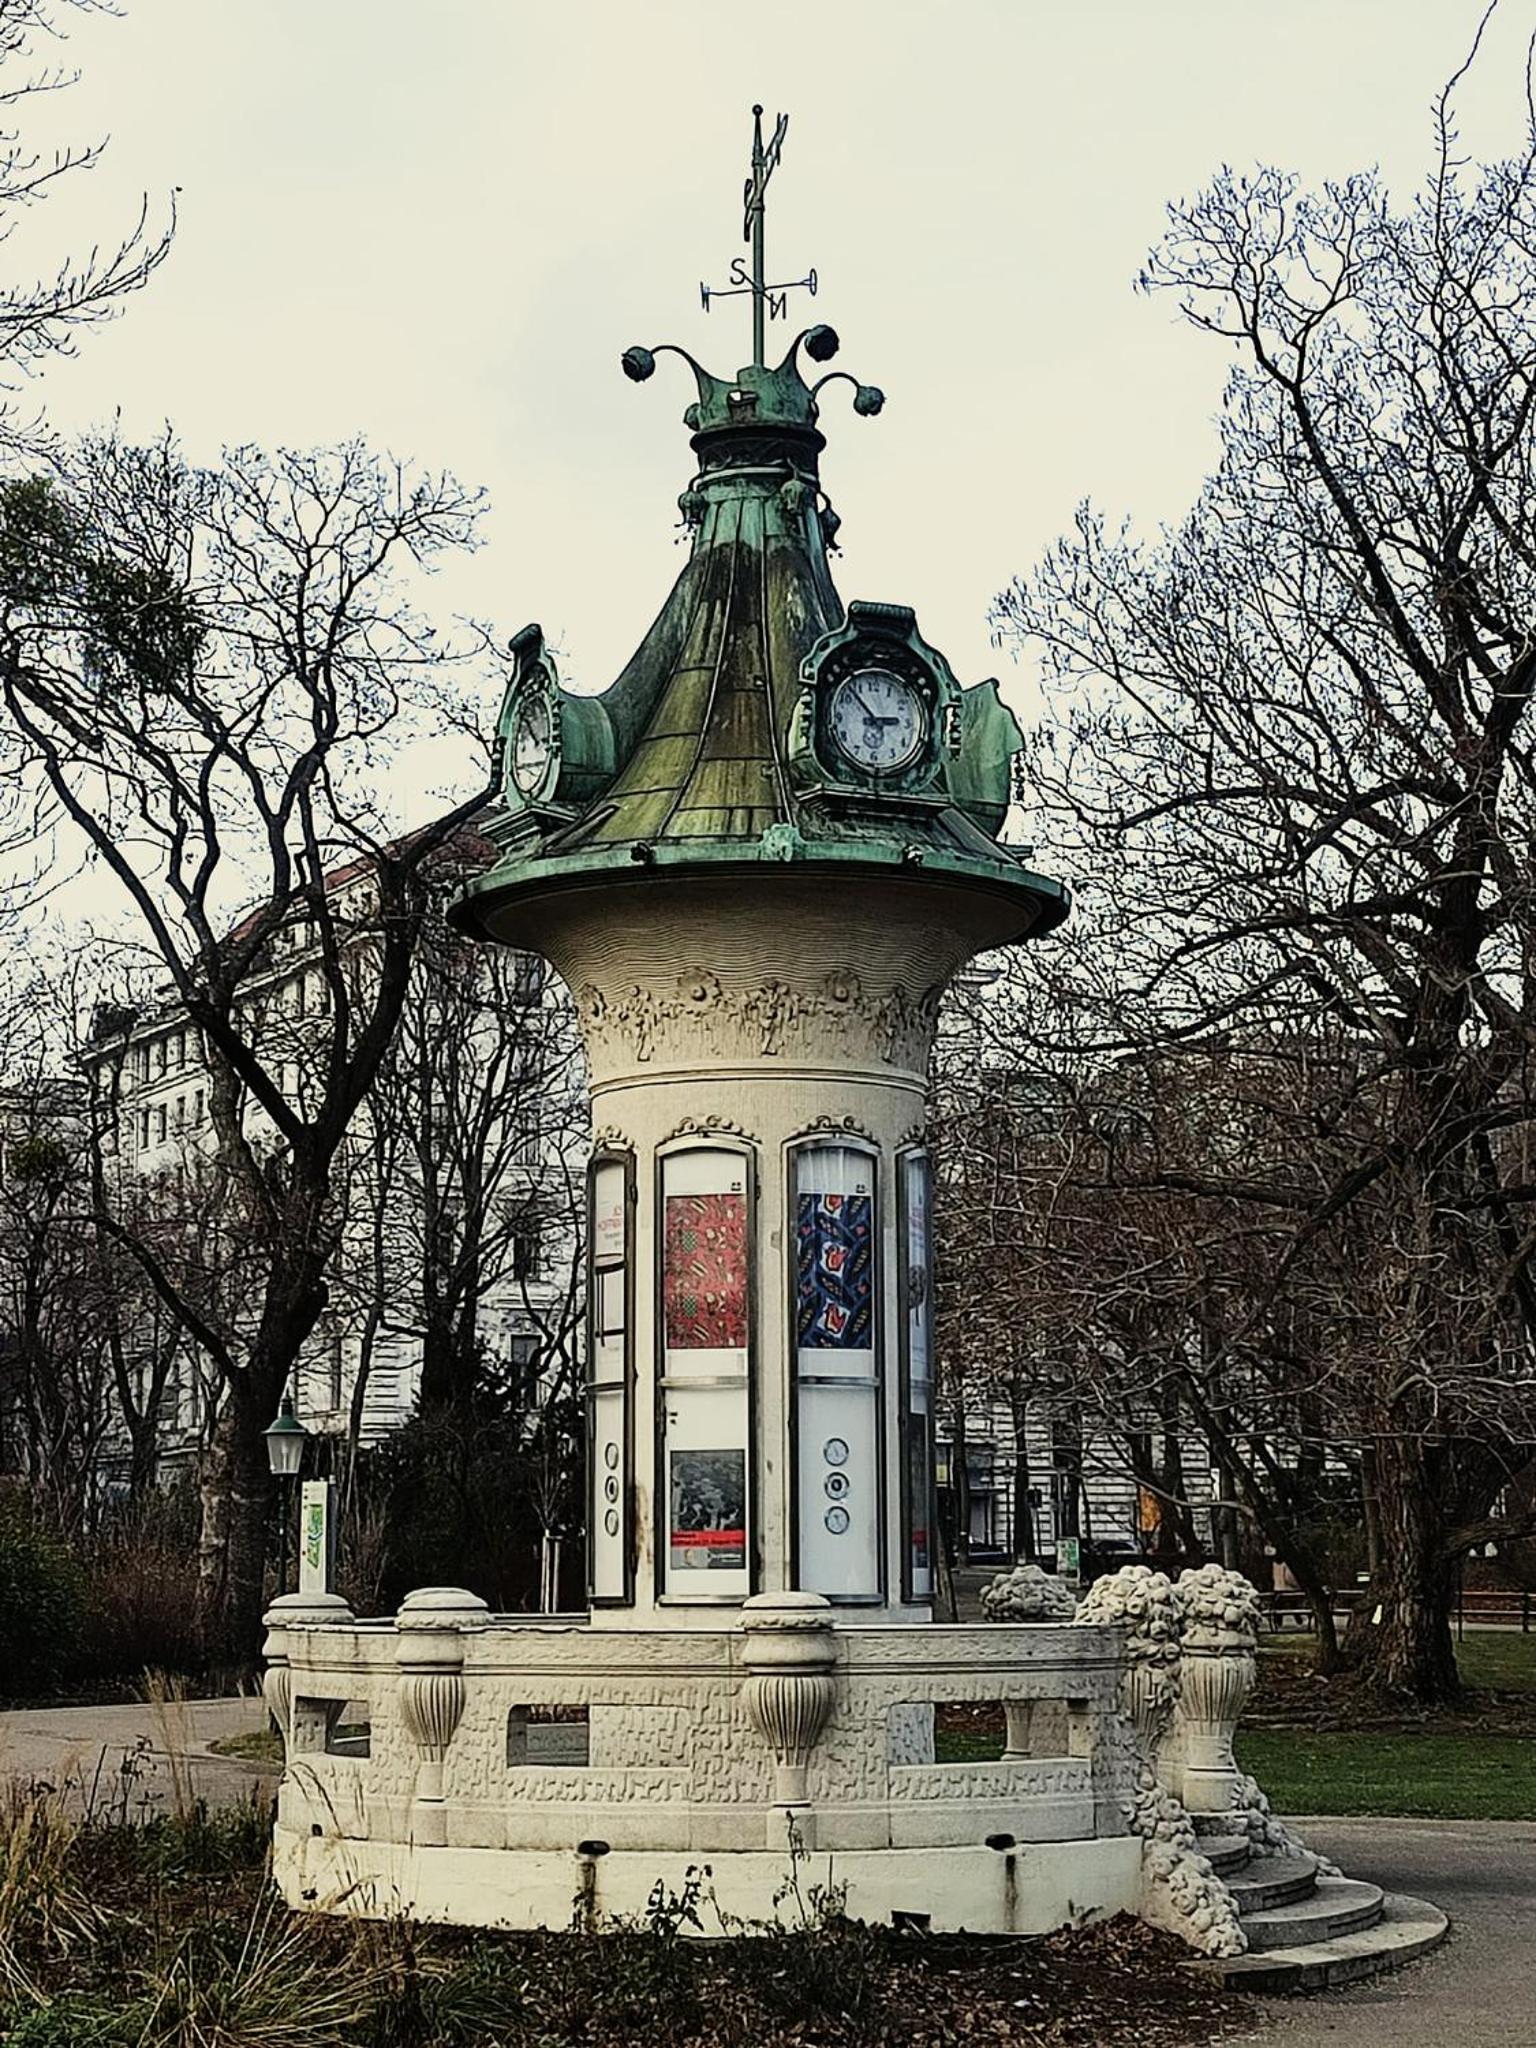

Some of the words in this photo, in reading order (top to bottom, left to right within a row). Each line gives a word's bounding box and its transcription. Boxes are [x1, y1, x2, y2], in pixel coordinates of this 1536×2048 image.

[730, 258, 746, 285] S
[886, 686, 892, 698] 1
[904, 718, 912, 730] 3
[853, 744, 861, 756] 7
[869, 750, 878, 761] 6
